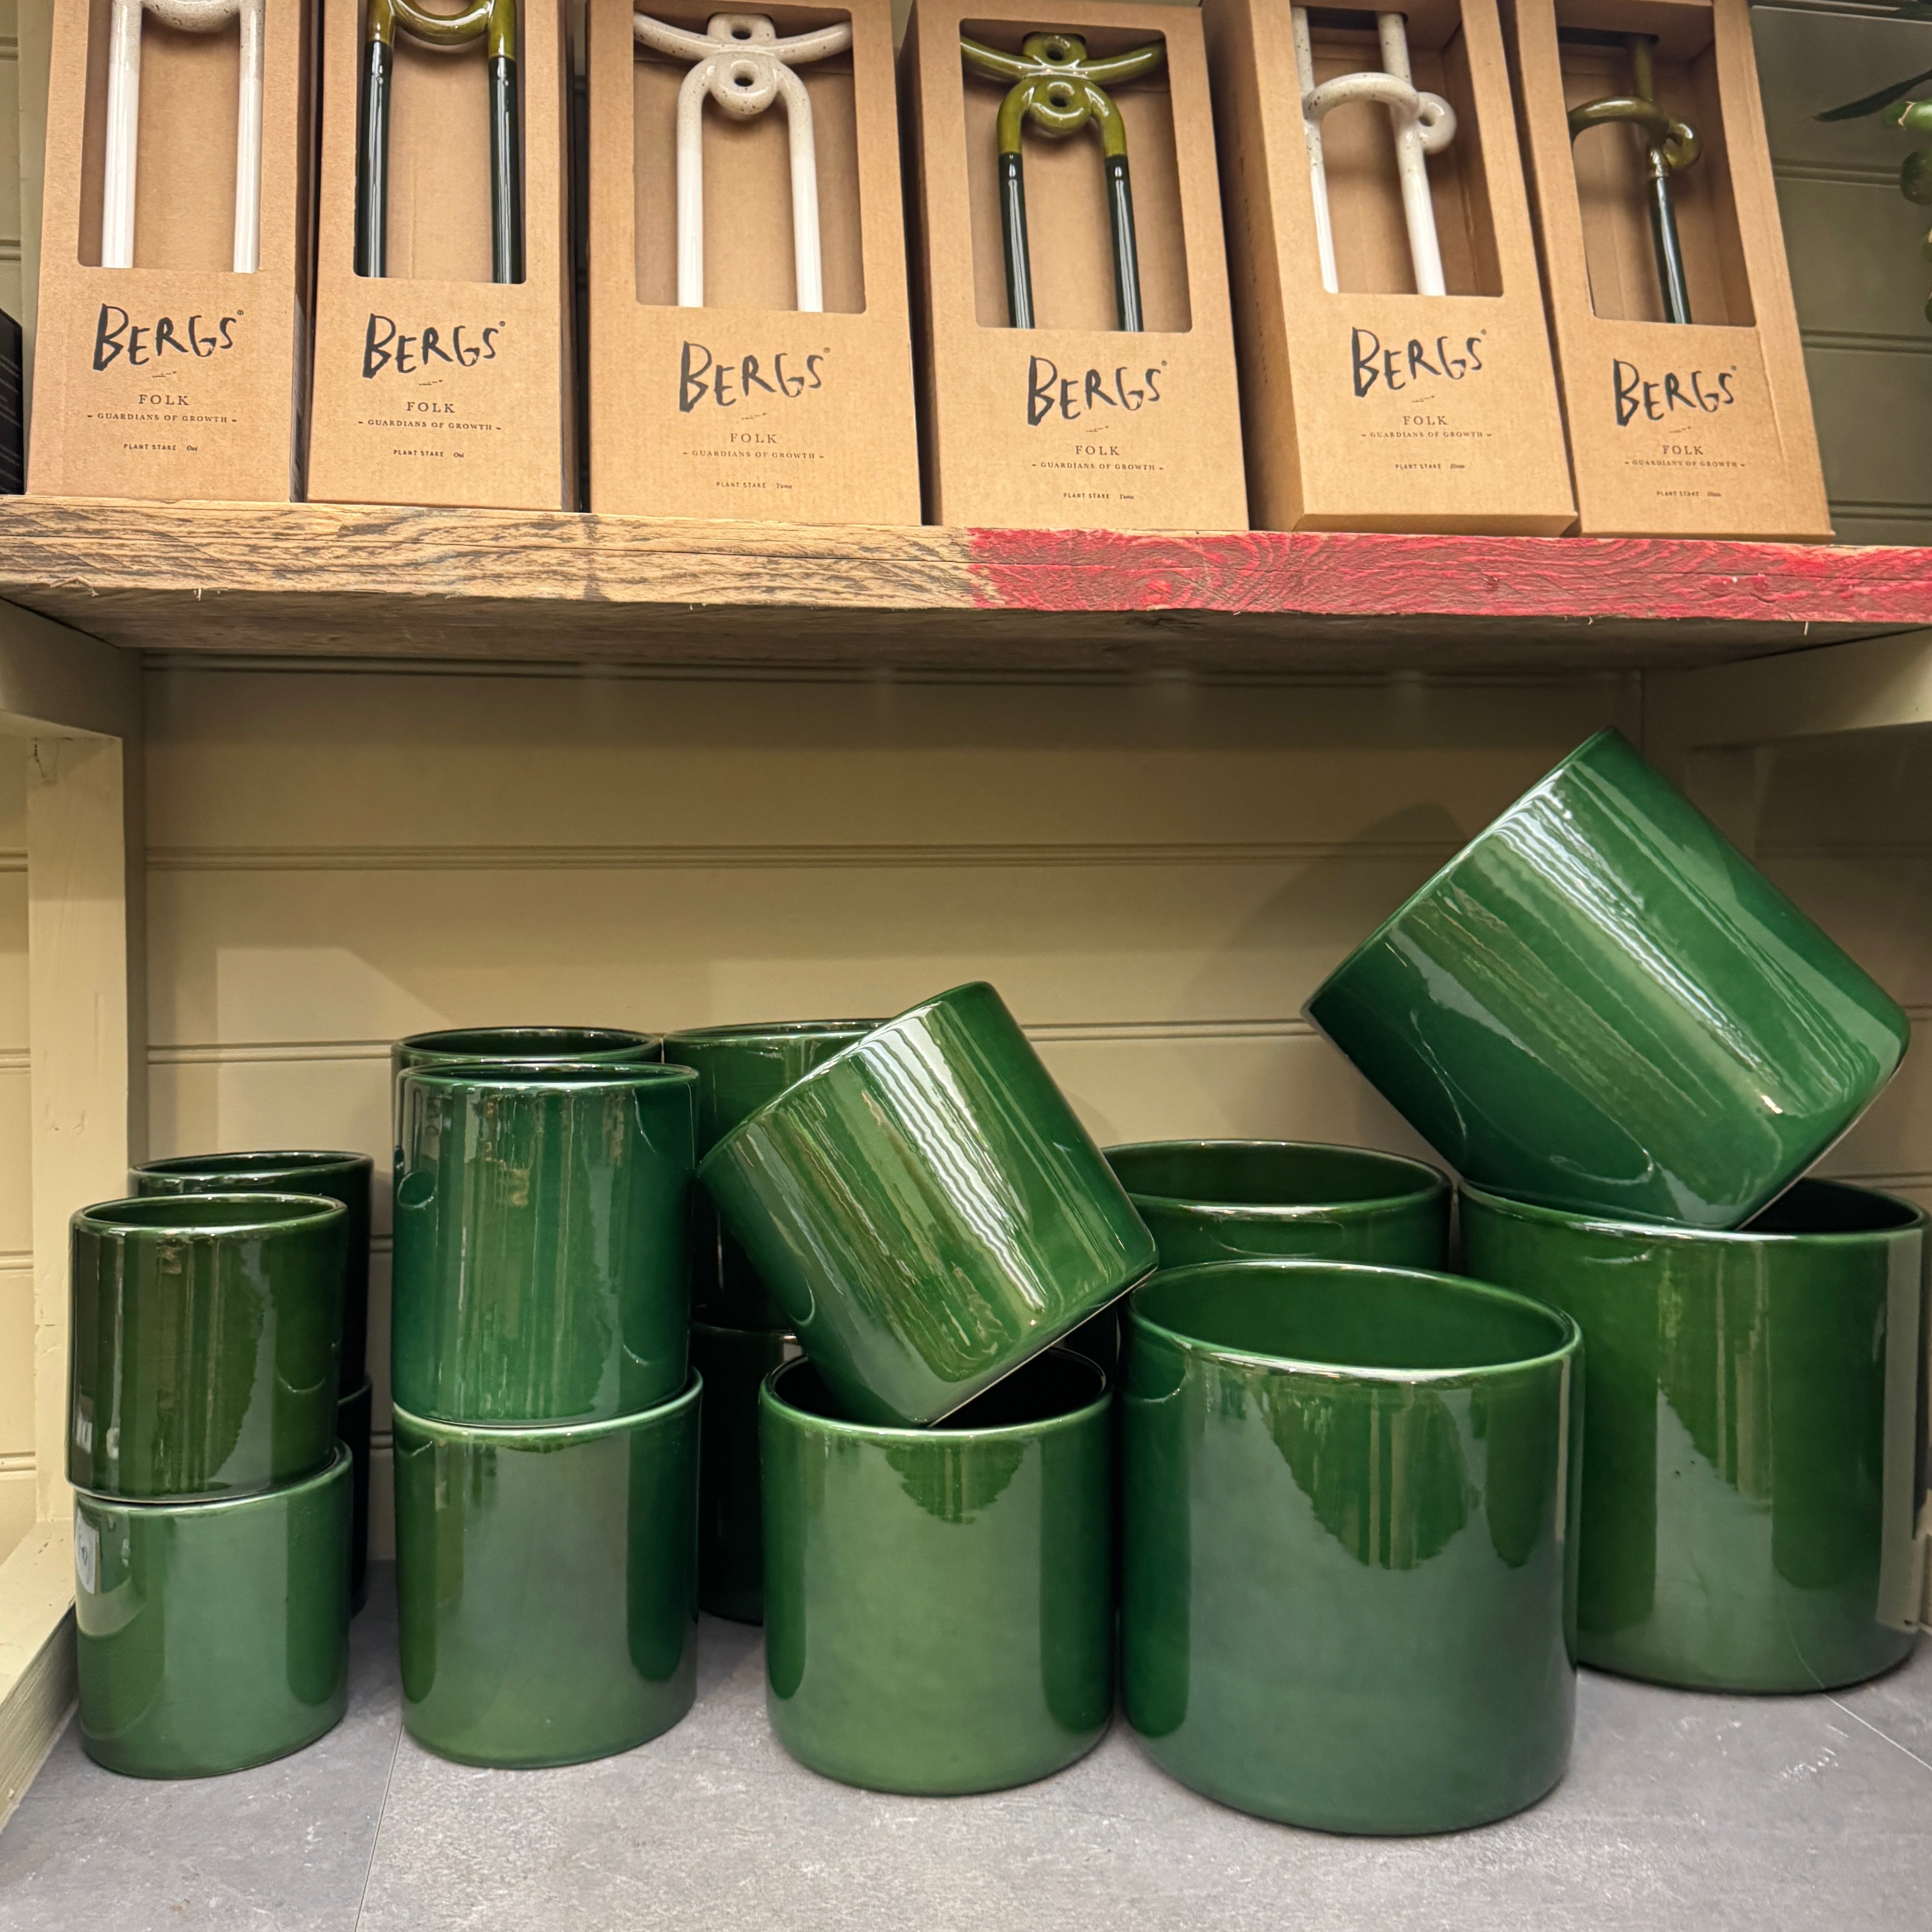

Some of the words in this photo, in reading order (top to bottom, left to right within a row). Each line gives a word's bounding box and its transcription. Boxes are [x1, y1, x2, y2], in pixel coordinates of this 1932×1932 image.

[138, 394, 189, 406] FOLK
[407, 402, 455, 413] FOLK
[1402, 415, 1448, 425] FOLK
[730, 433, 777, 443] FOLK
[1075, 445, 1119, 456] FOLK
[1662, 445, 1704, 455] FOLK
